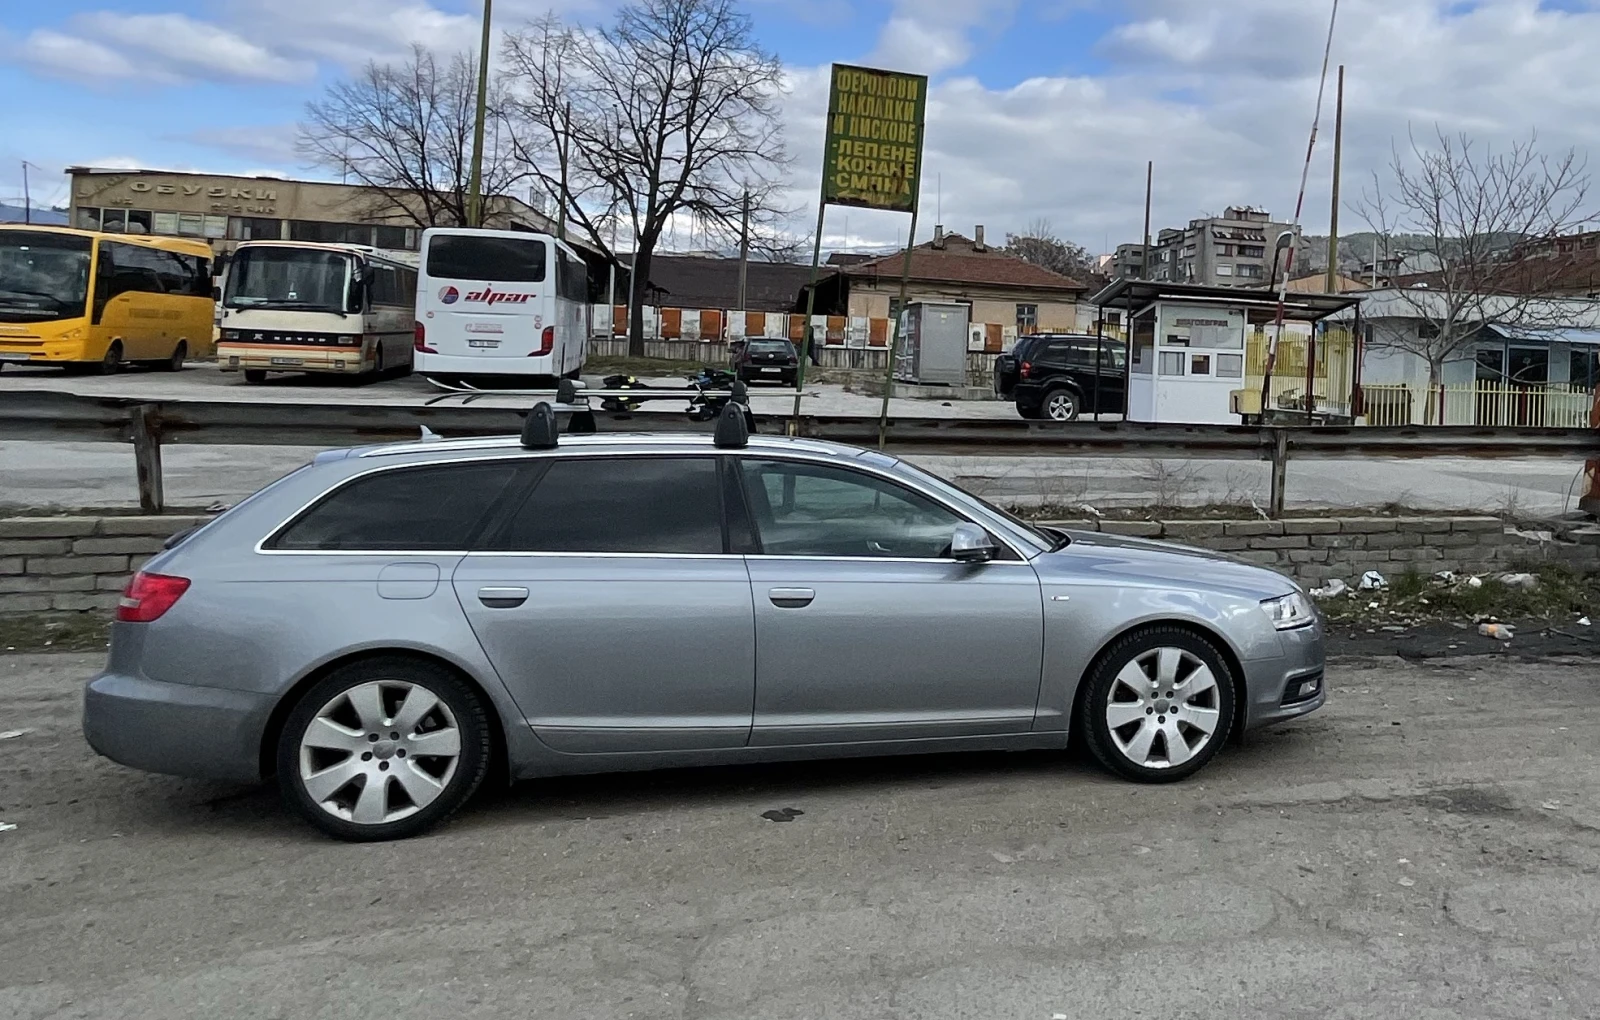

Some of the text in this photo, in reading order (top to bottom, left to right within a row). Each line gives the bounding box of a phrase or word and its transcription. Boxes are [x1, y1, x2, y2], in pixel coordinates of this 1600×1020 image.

[837, 71, 918, 100] ФЕРОДОВИ
[838, 92, 915, 122] НАКЛАДКИ
[833, 114, 916, 144] И ДИСКОВЕ
[464, 287, 537, 306] alpar
